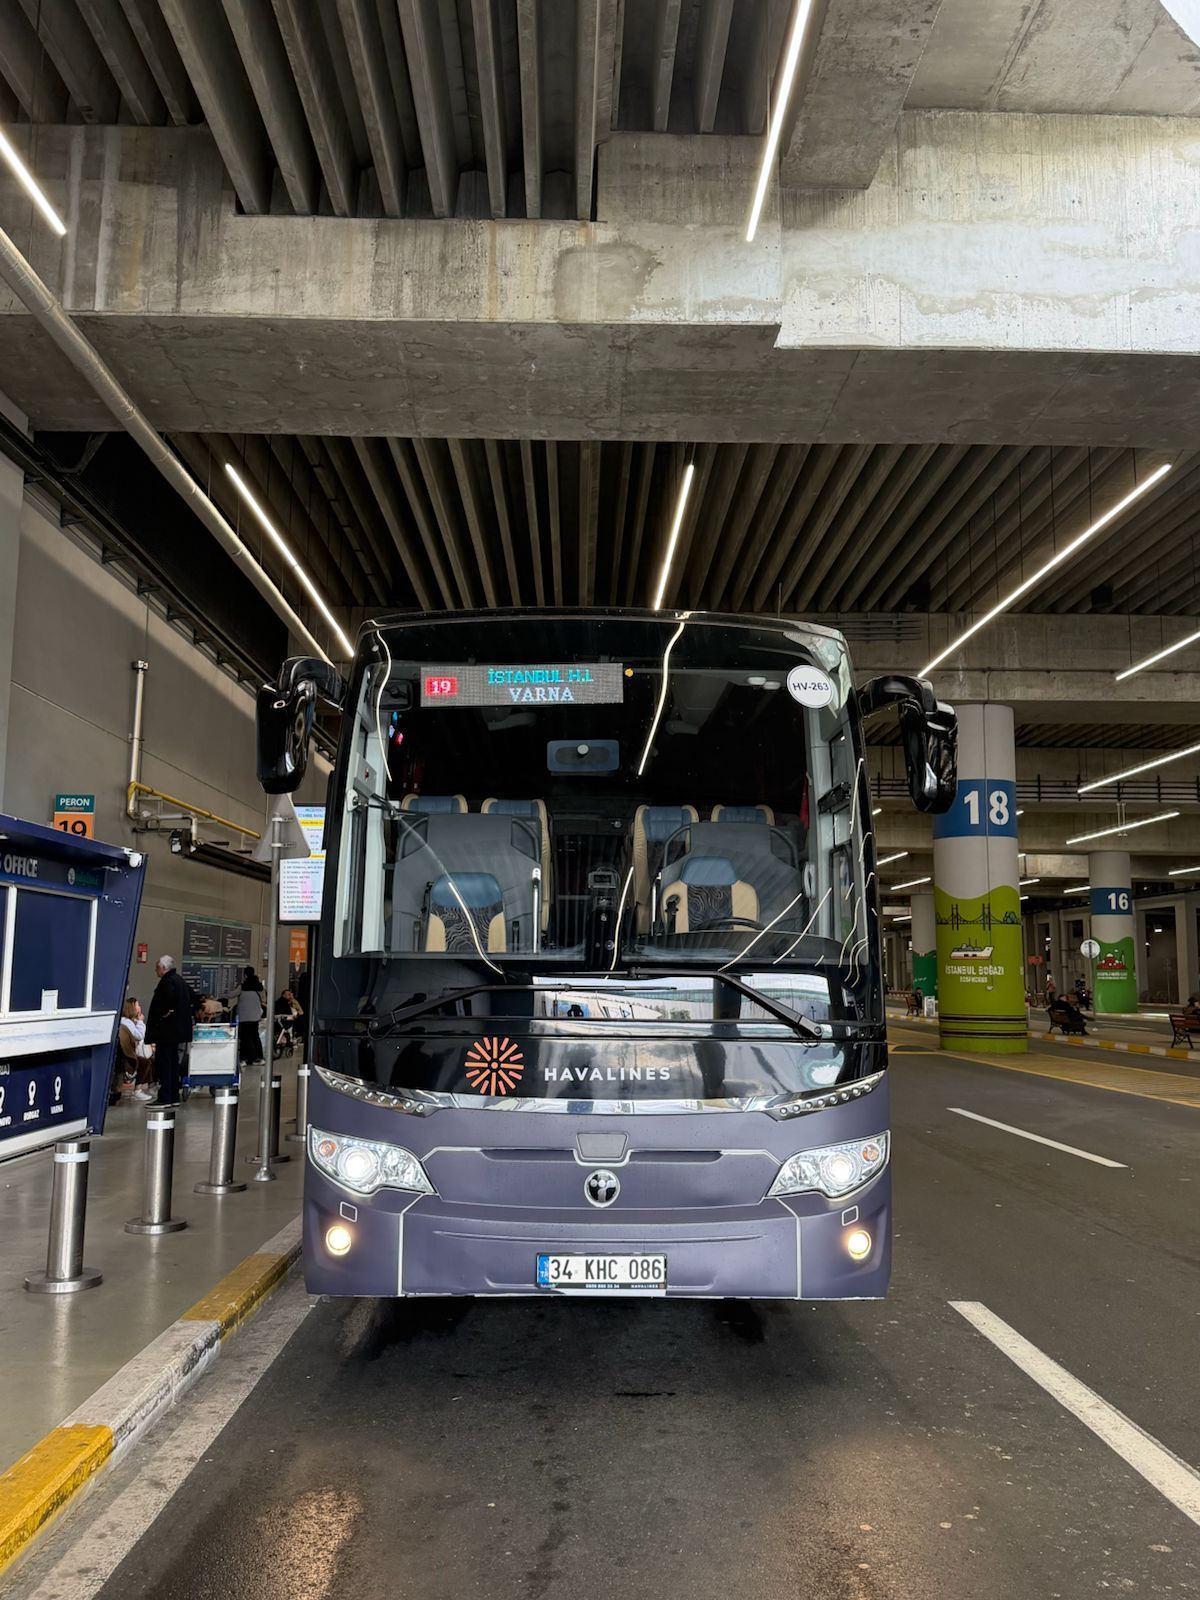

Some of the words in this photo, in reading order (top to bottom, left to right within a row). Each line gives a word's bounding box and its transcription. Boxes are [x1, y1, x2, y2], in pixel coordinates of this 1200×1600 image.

[431, 680, 451, 694] 19
[792, 682, 829, 691] HV-263
[508, 687, 574, 702] VARNA
[60, 798, 90, 806] PERON
[963, 790, 1009, 826] 18
[59, 820, 87, 836] 19
[4, 854, 38, 877] OFFICE
[1107, 892, 1129, 910] 16
[544, 1067, 671, 1081] HAVALINES
[551, 1259, 573, 1280] 34
[585, 1259, 618, 1280] KHC
[629, 1259, 662, 1280] 086
